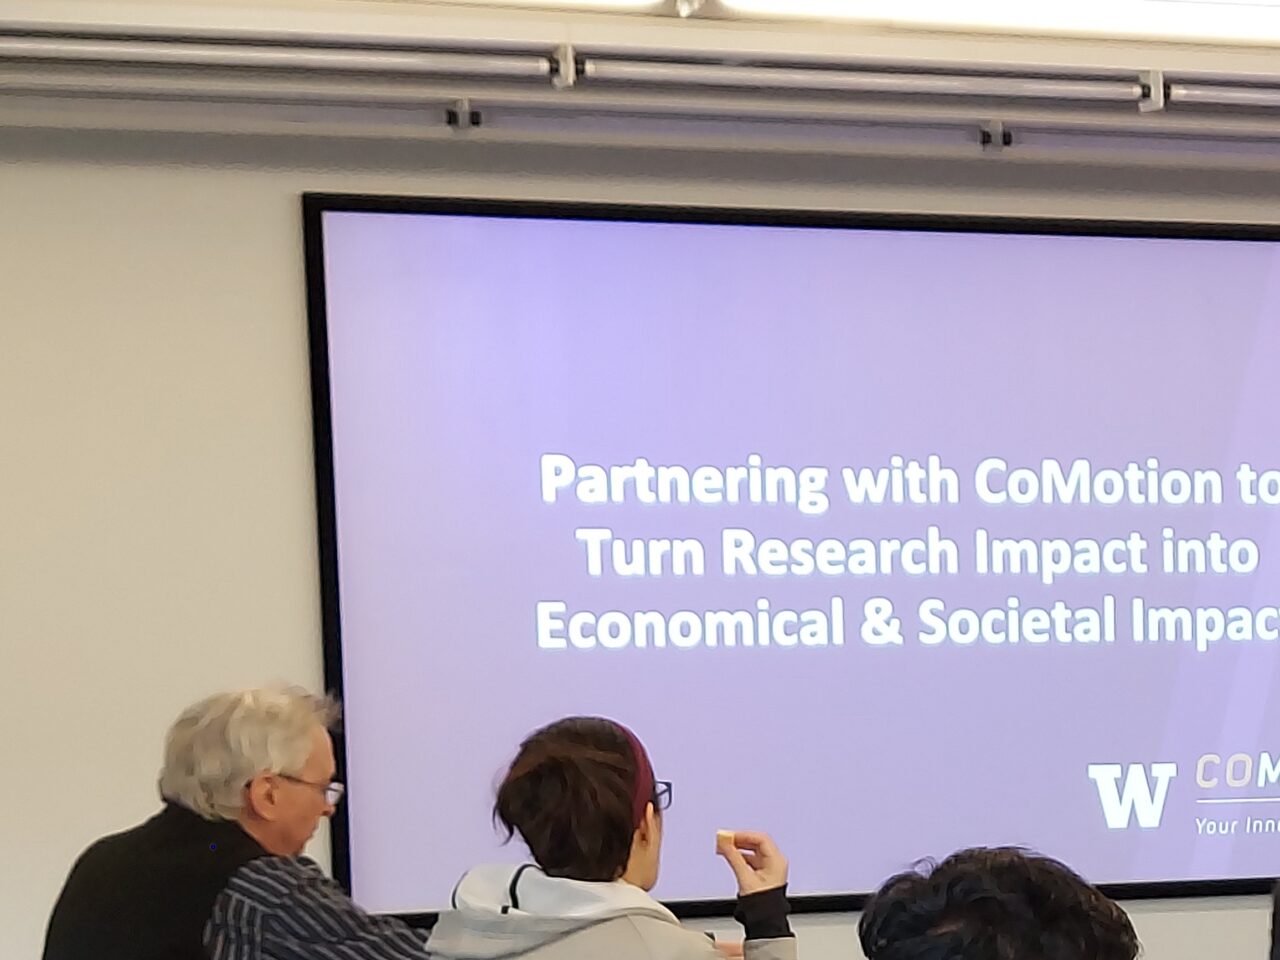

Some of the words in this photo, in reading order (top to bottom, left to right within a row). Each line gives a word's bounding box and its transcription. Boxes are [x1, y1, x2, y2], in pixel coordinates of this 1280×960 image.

[540, 453, 829, 515] Partnering
[842, 455, 959, 504] with
[974, 457, 1223, 505] CoMotion
[575, 528, 705, 576] Turn
[722, 526, 958, 576] Research
[975, 529, 1148, 585] Impact
[1162, 527, 1259, 574] into
[536, 597, 844, 649] Economical
[860, 598, 904, 645] &
[918, 595, 1115, 645] Societal
[1087, 763, 1177, 830] W
[1195, 816, 1238, 835] Your
